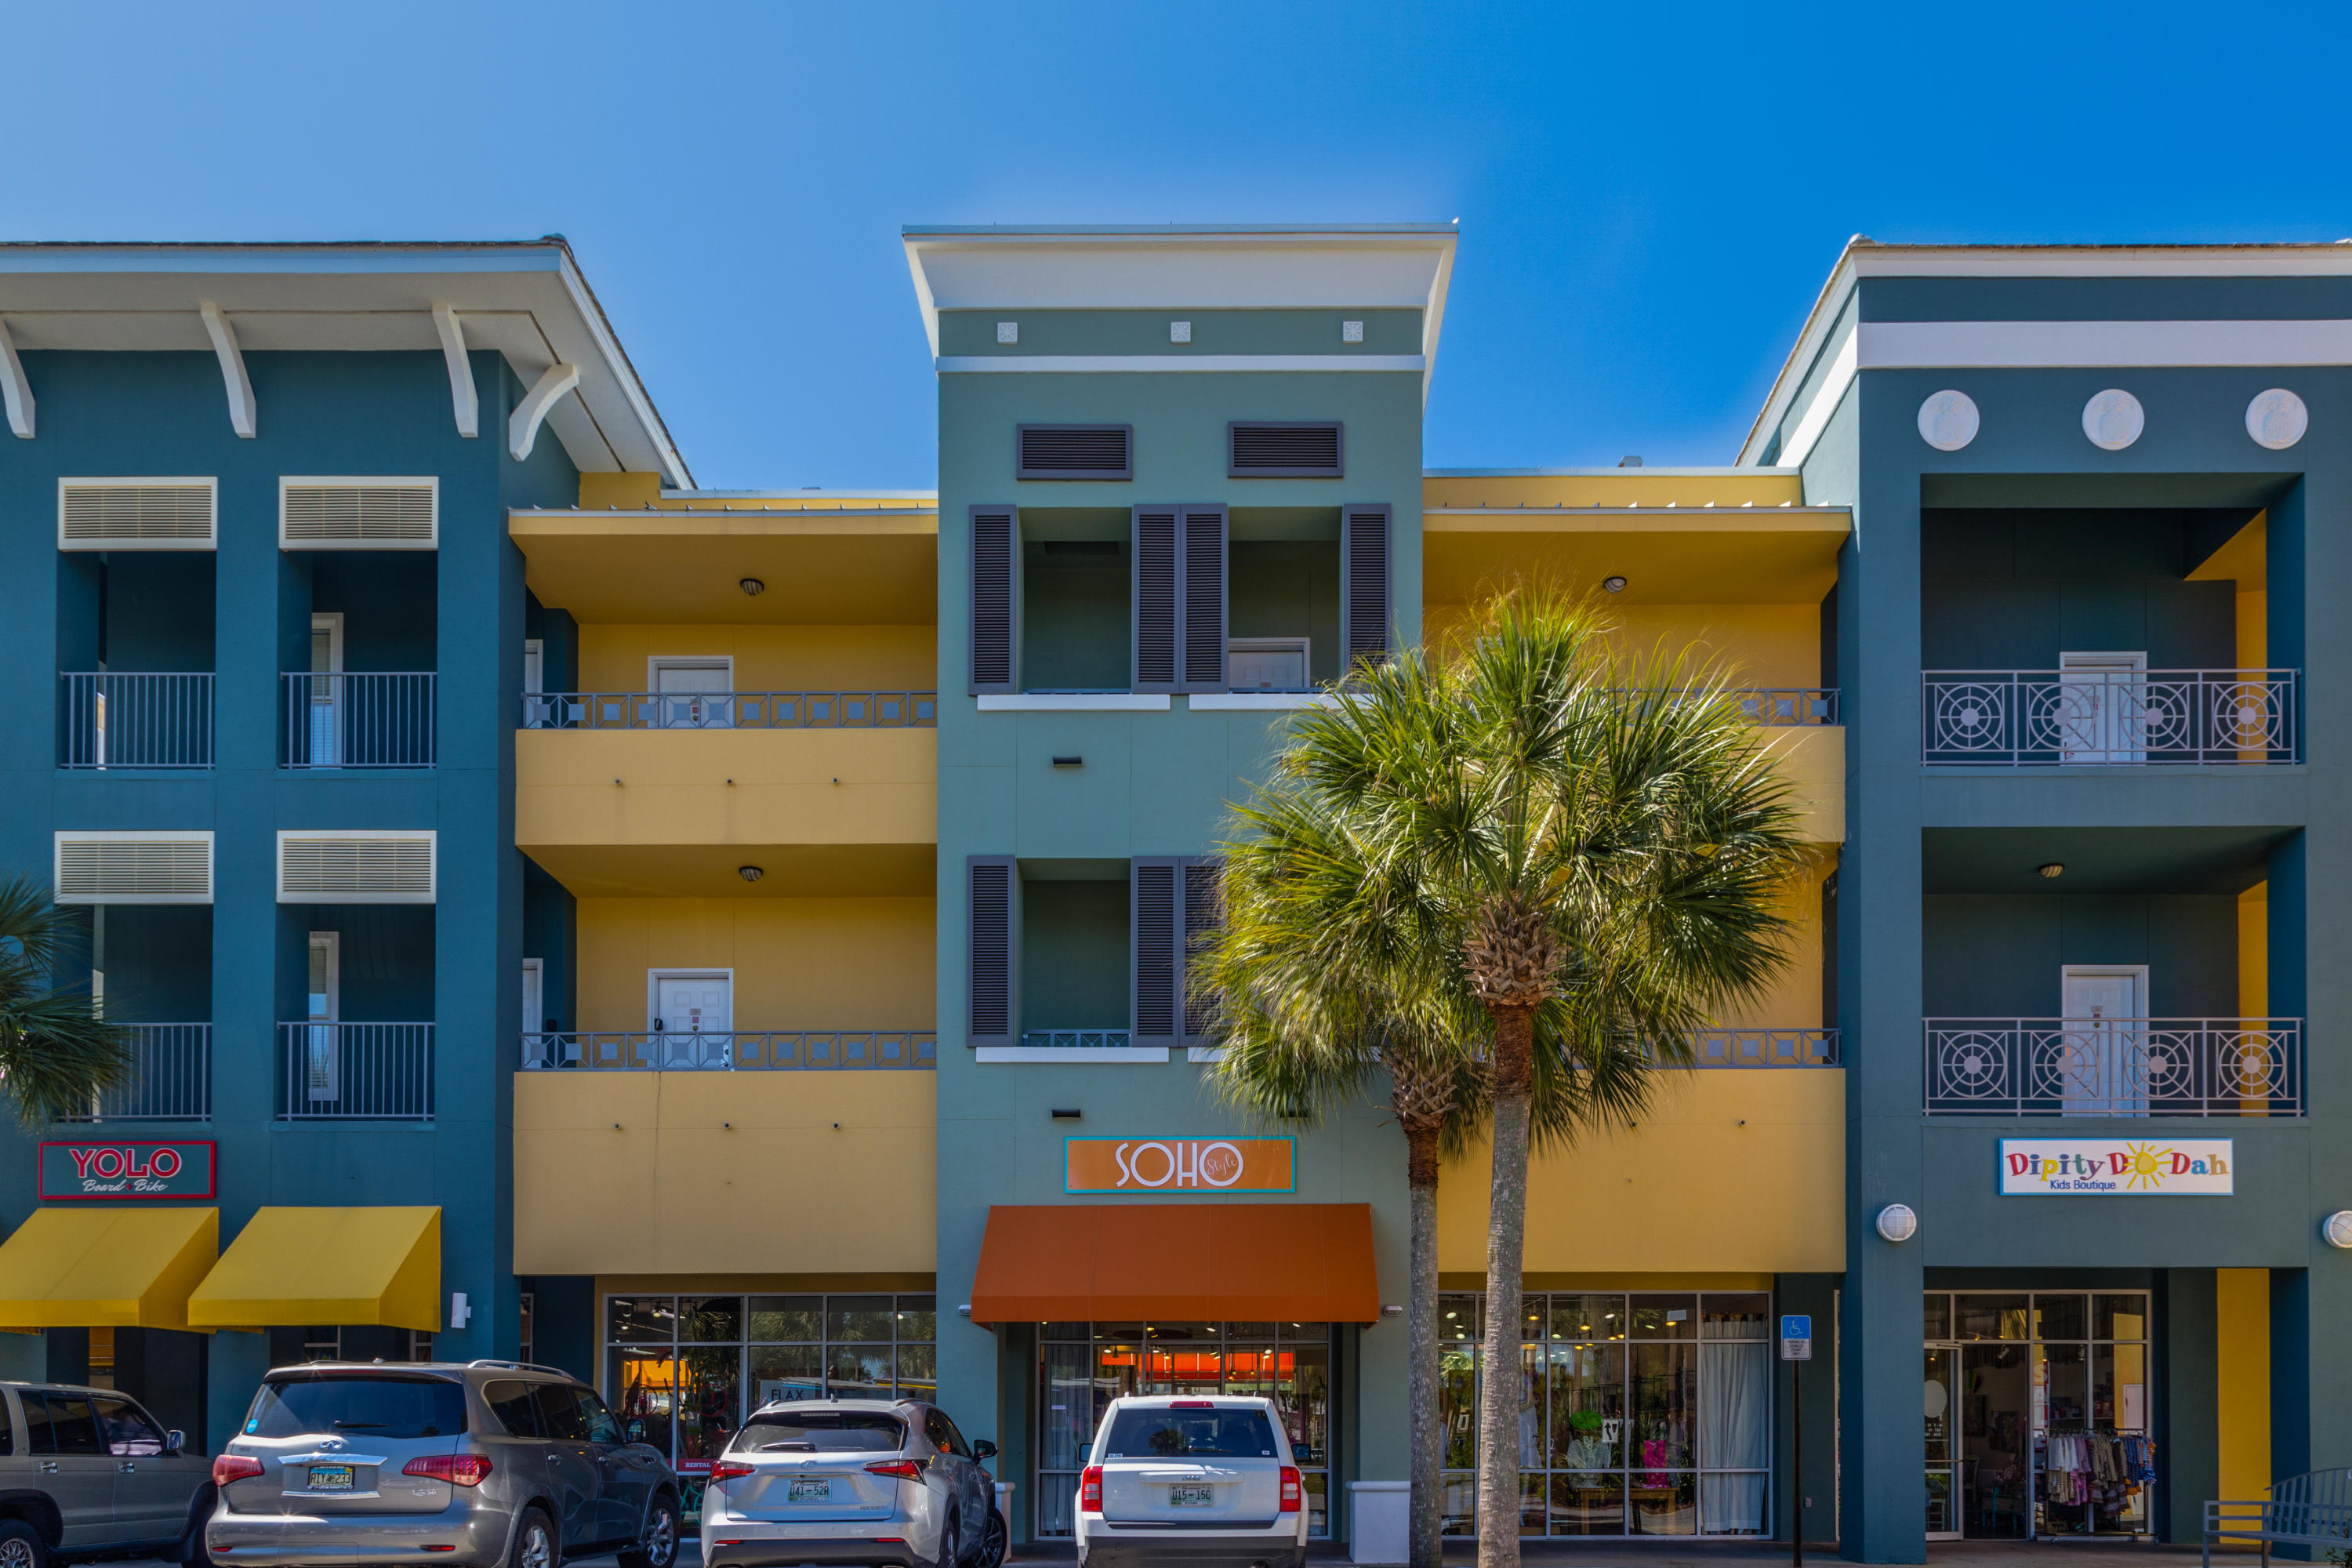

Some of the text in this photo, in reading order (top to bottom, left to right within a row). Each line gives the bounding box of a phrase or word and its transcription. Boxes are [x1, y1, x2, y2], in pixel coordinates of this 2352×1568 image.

[69, 1148, 182, 1178] YOLO
[1116, 1142, 1243, 1187] SOHO
[1207, 1154, 1236, 1175] Style
[2170, 1152, 2229, 1175] Dah
[83, 1179, 168, 1192] Board Bike
[2050, 1180, 2116, 1191] Kids Boutique
